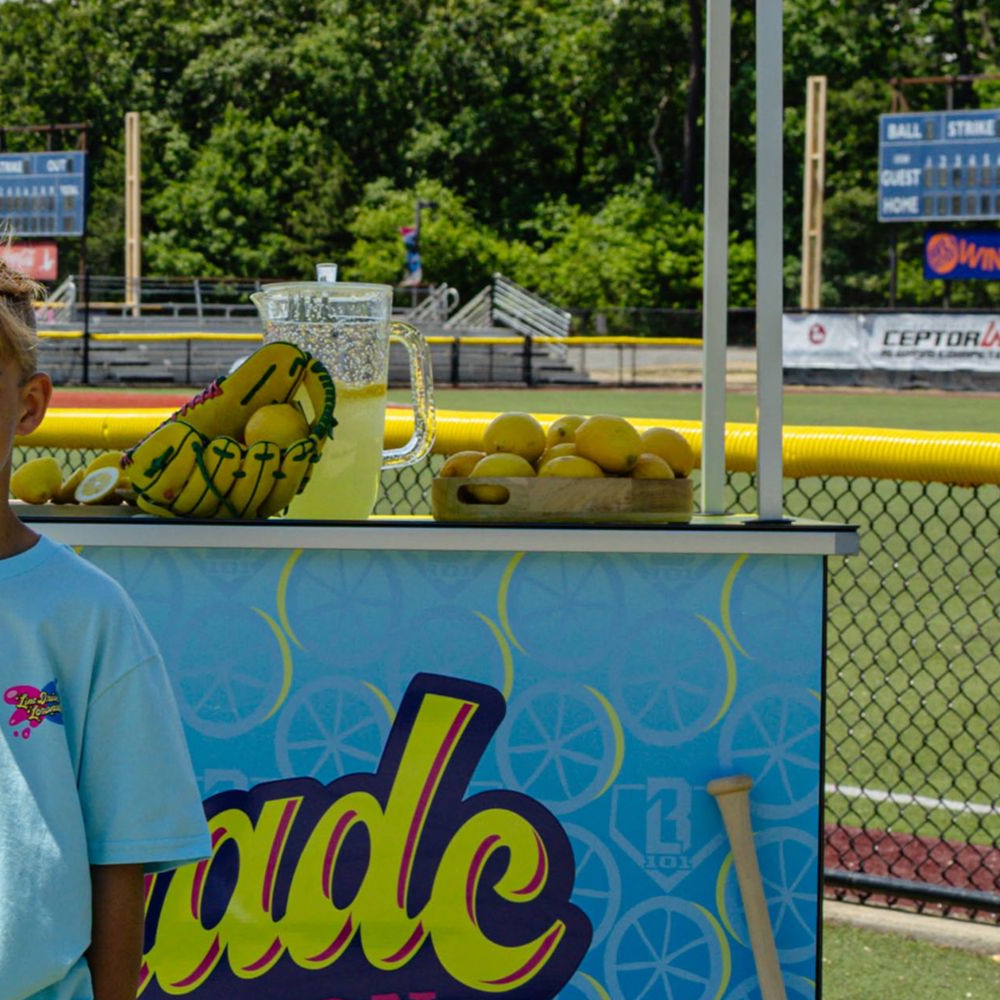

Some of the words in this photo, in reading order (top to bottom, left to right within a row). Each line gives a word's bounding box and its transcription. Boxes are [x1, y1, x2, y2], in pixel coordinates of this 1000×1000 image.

[887, 122, 922, 140] BALL
[947, 119, 995, 137] STRIKE
[881, 168, 921, 187] GUEST
[883, 196, 919, 214] HOME
